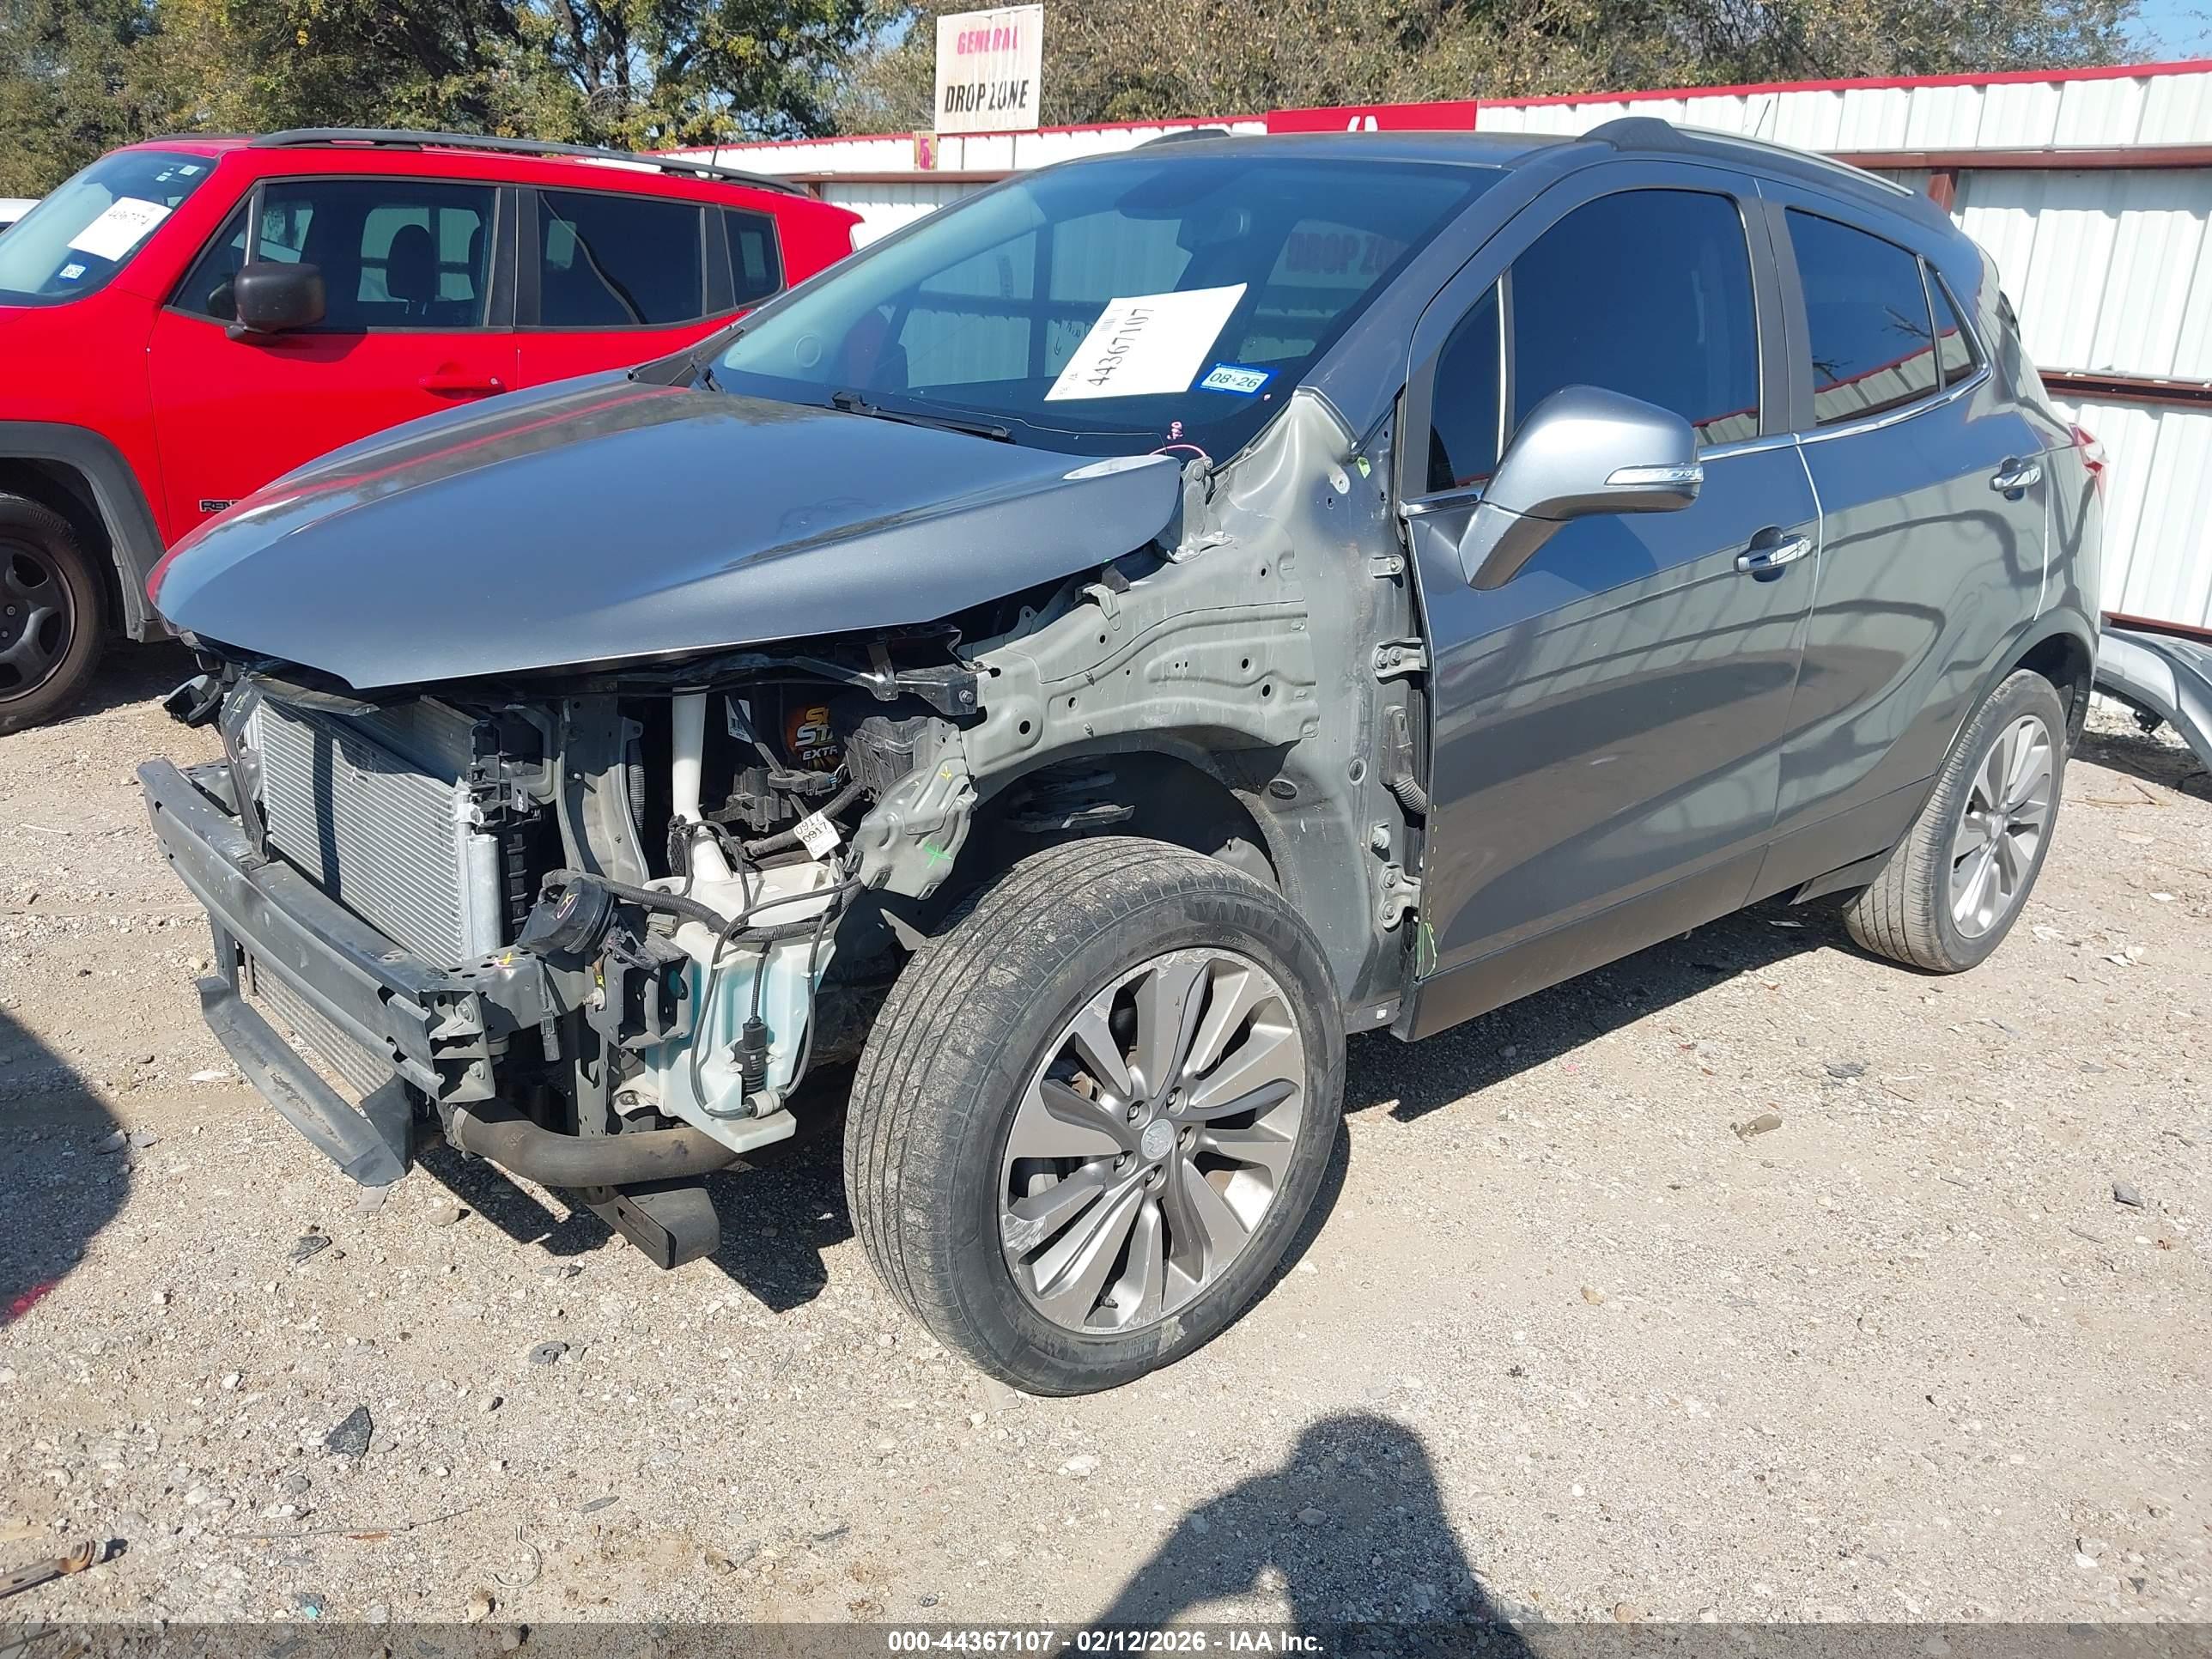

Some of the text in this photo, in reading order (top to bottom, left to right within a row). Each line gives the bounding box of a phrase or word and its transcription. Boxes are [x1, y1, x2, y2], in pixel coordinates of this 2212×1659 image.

[945, 79, 1030, 113] DROP ZONE
[1087, 309, 1153, 386] 44367107
[802, 821, 828, 842] 0917
